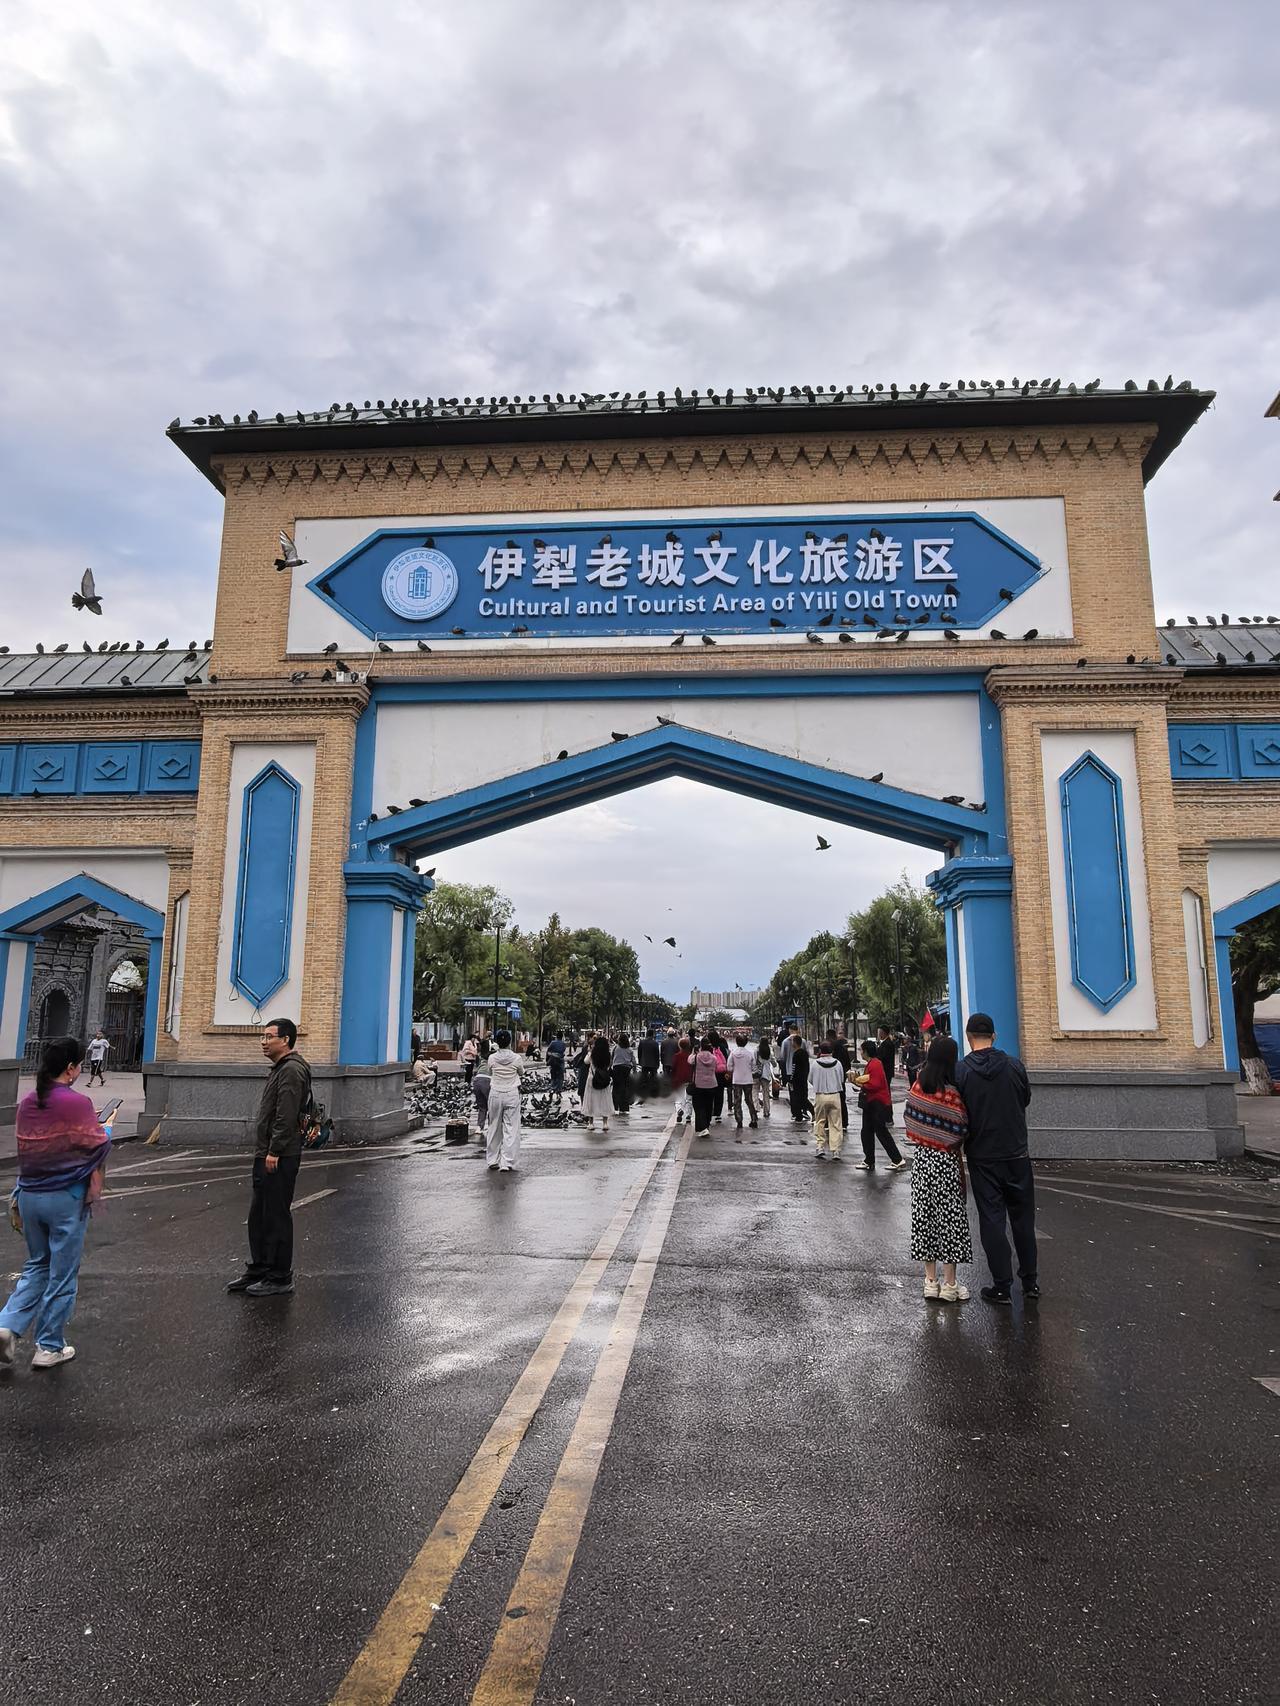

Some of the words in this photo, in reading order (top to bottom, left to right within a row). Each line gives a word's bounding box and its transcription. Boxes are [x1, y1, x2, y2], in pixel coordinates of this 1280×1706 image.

[478, 536, 958, 590] 伊犁老城文化旅游区
[479, 596, 570, 616] Cultural
[576, 595, 617, 615] and
[623, 594, 707, 613] Tourist
[712, 592, 766, 612] Area
[771, 592, 795, 611] of
[799, 591, 838, 610] Yili
[844, 590, 885, 609] Old
[890, 589, 958, 609] Town
